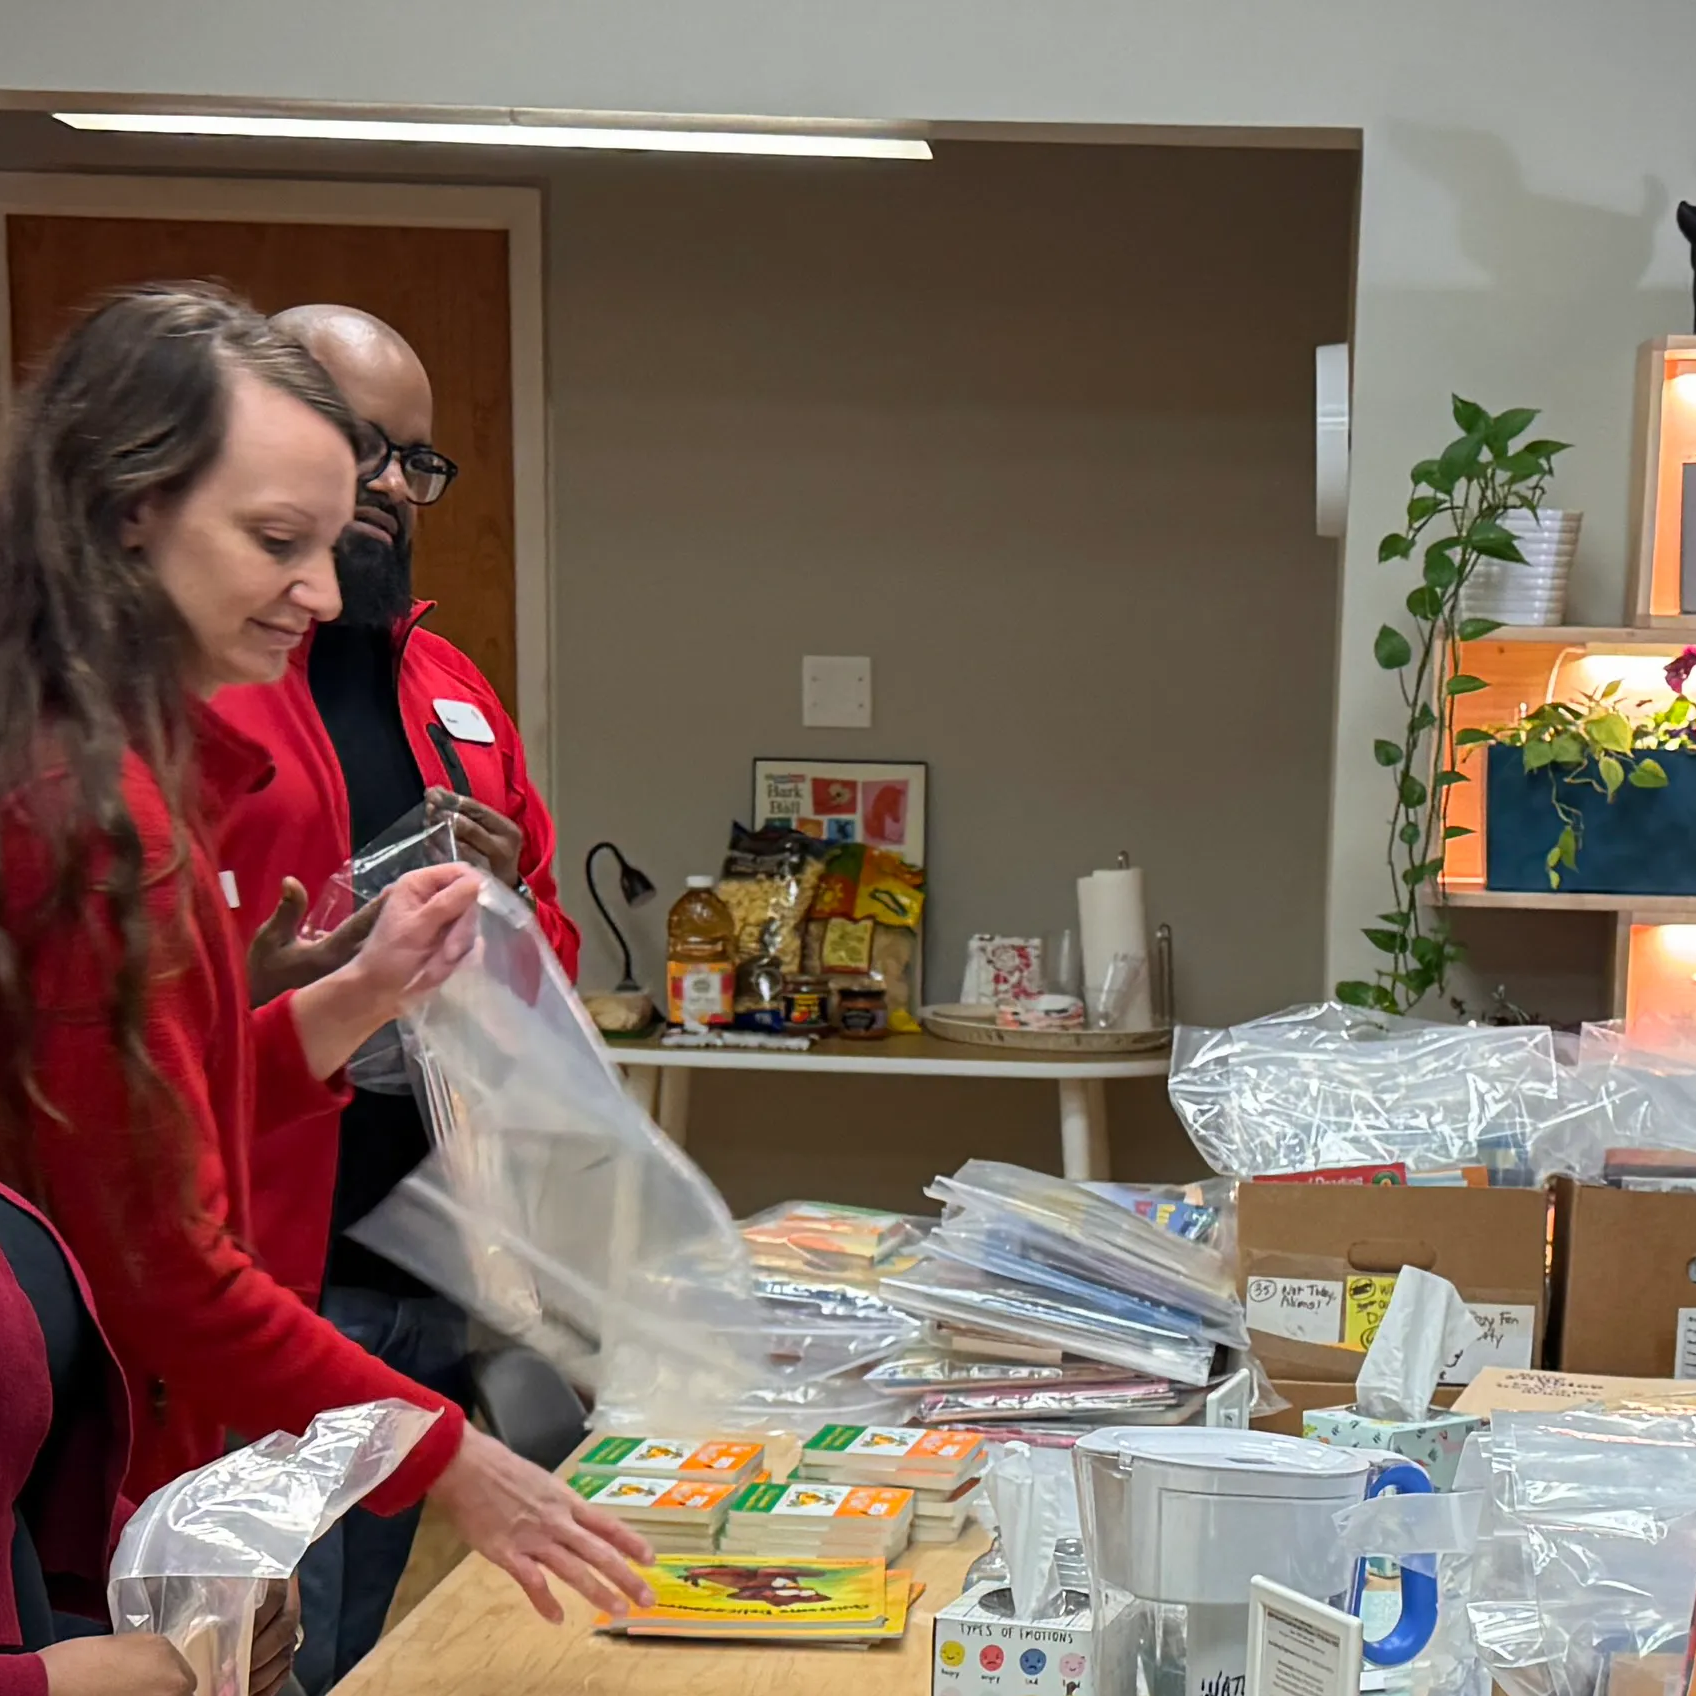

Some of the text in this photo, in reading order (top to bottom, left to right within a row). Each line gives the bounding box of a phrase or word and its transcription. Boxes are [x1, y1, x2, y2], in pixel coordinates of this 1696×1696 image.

[1252, 1283, 1273, 1297] 35
[959, 1623, 1074, 1644] TYPES OF EMOTIONS
